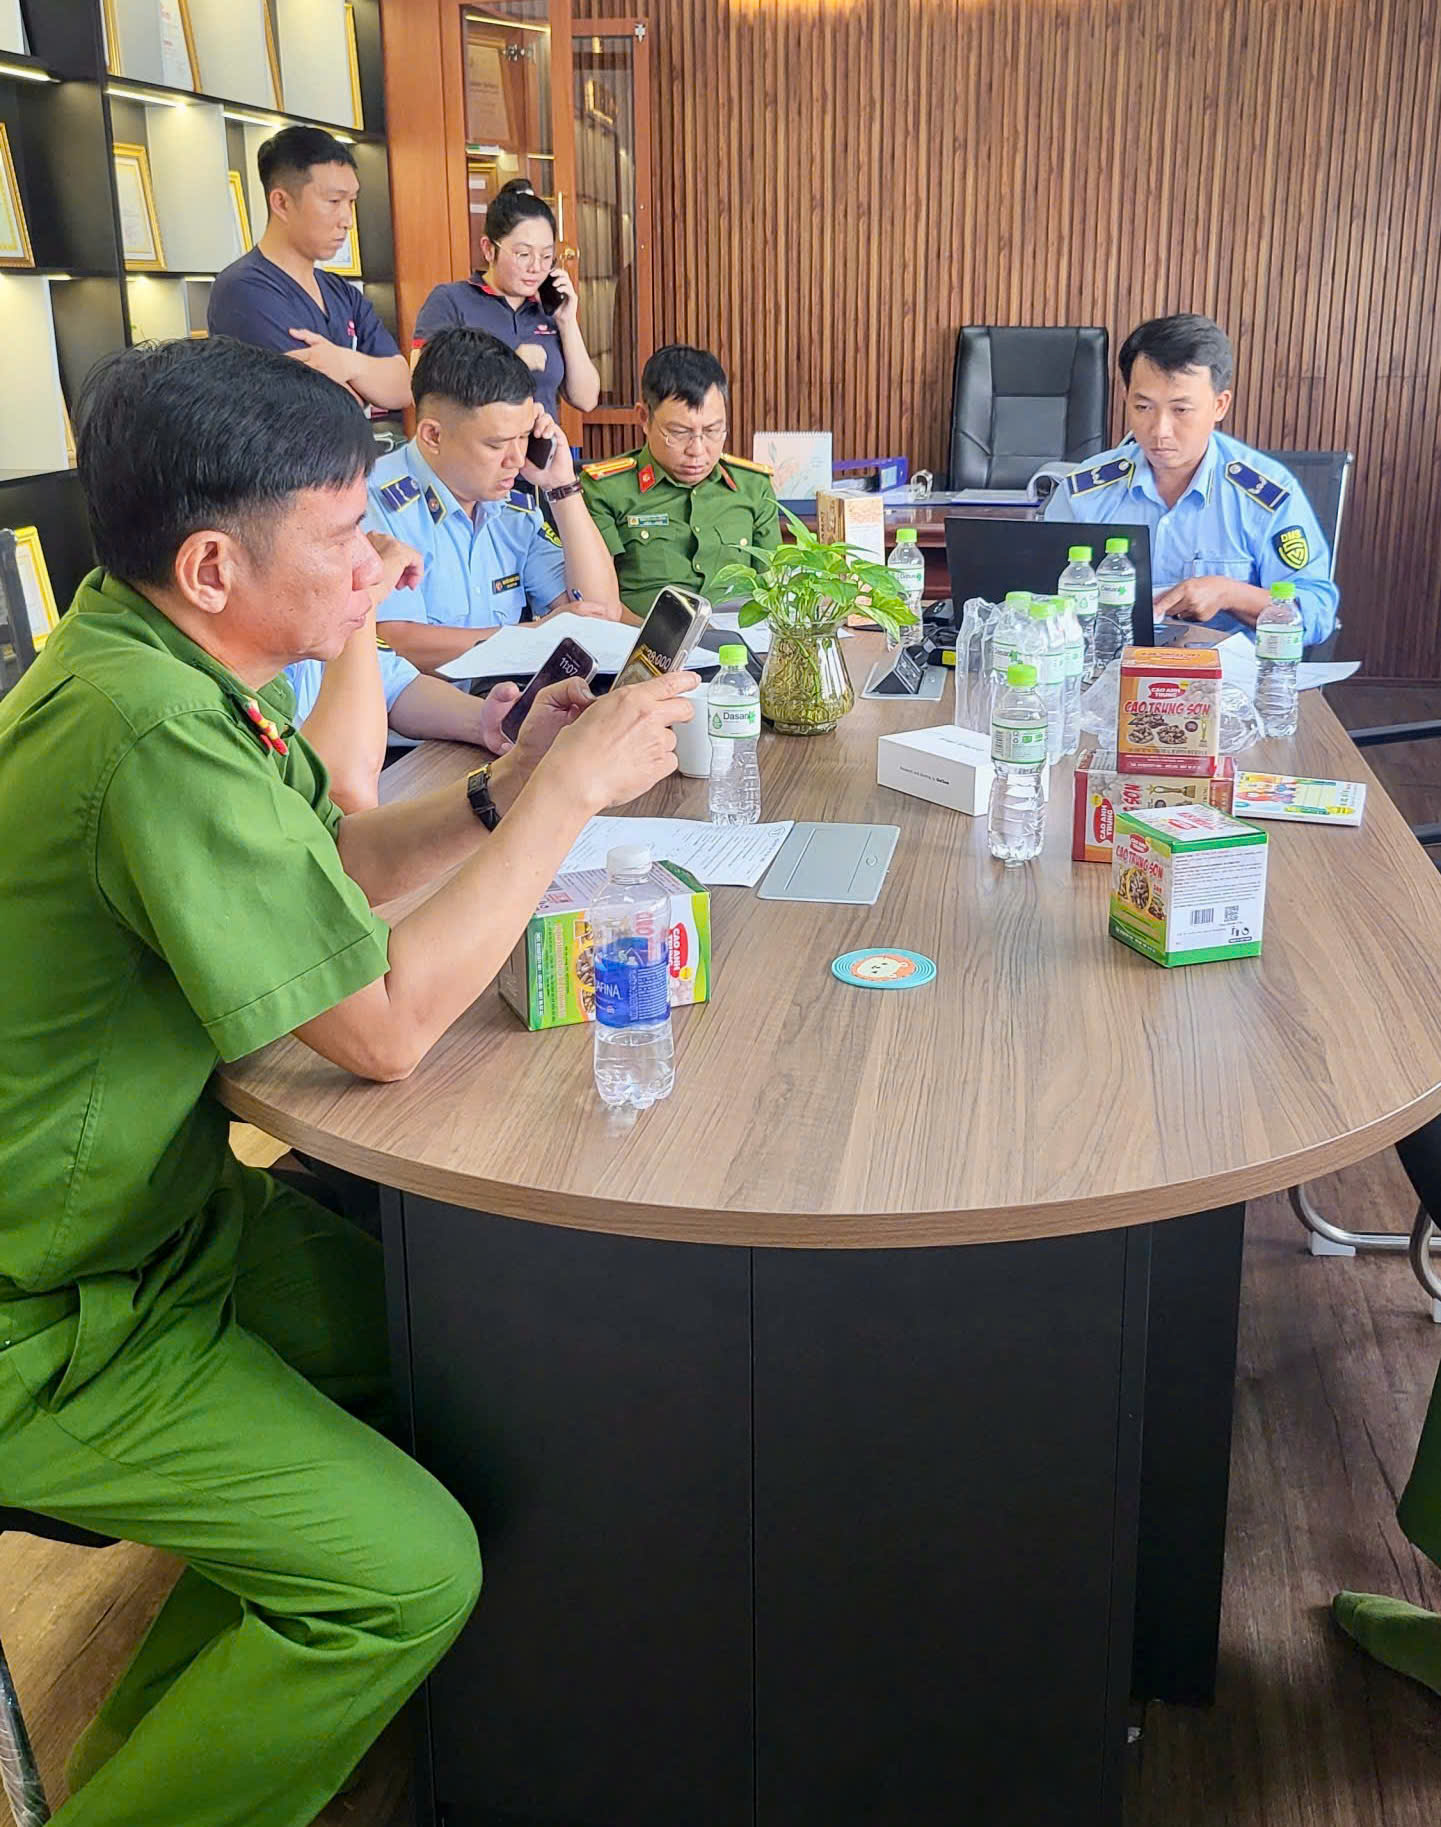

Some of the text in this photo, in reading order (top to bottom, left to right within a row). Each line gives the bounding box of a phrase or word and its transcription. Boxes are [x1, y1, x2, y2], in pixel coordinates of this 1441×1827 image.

[560, 657, 578, 676] 11:07
[1124, 701, 1146, 713] CAO
[1149, 702, 1184, 715] TRUNG
[673, 928, 681, 948] CAO
